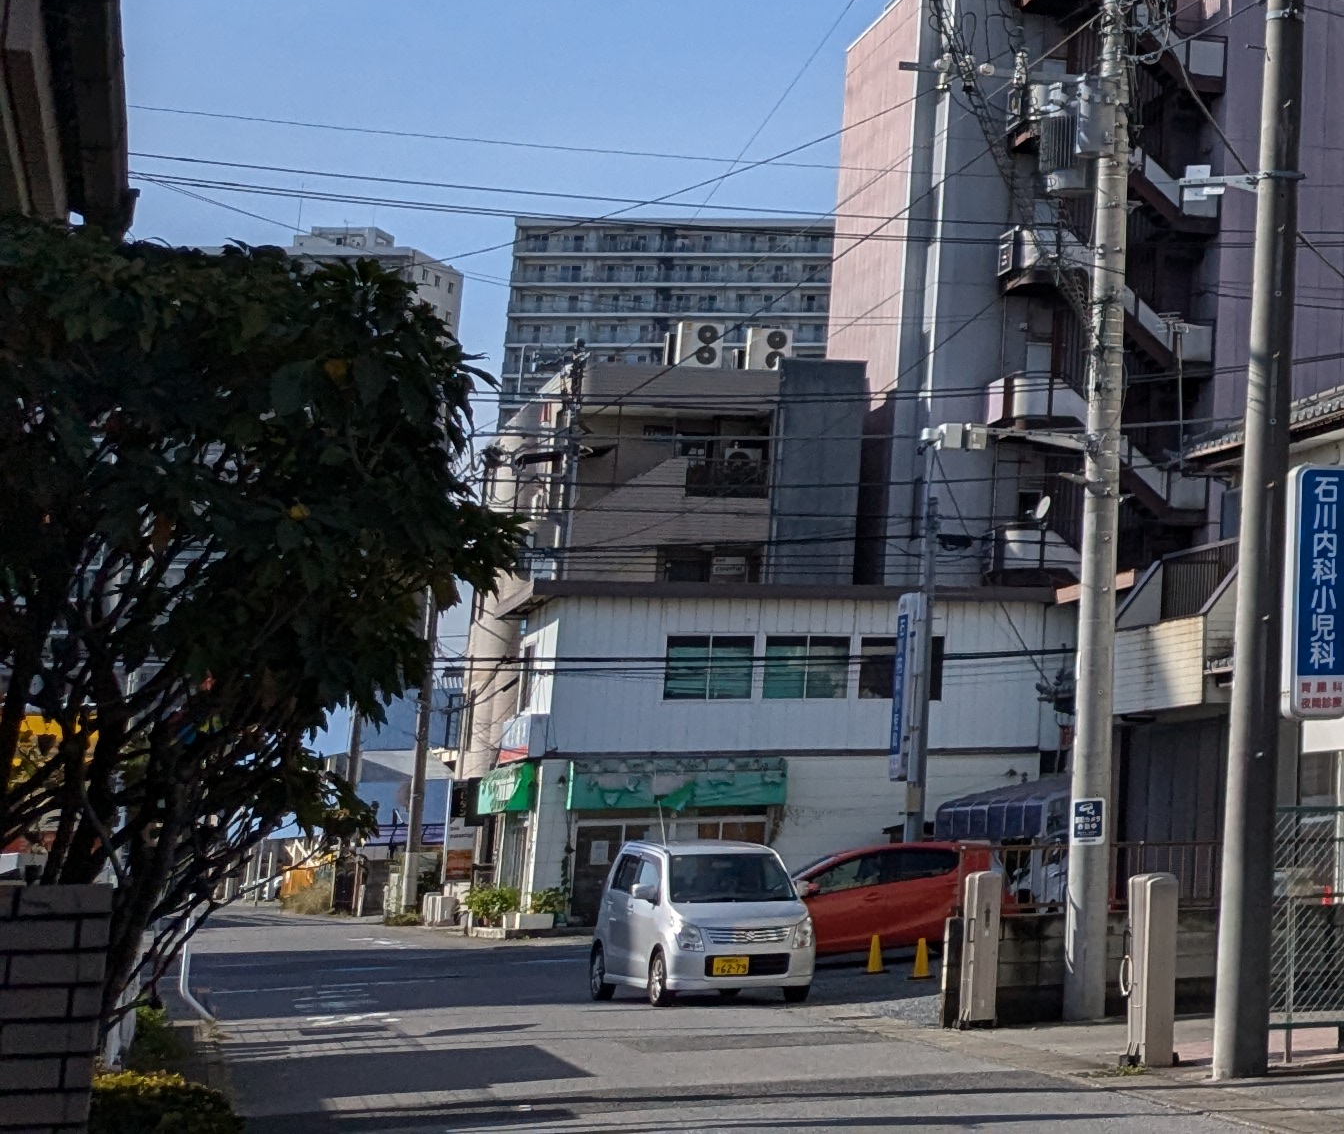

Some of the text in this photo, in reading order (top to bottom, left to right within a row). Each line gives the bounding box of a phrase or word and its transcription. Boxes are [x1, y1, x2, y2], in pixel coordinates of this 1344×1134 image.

[1310, 476, 1339, 670] 石川内科小児科
